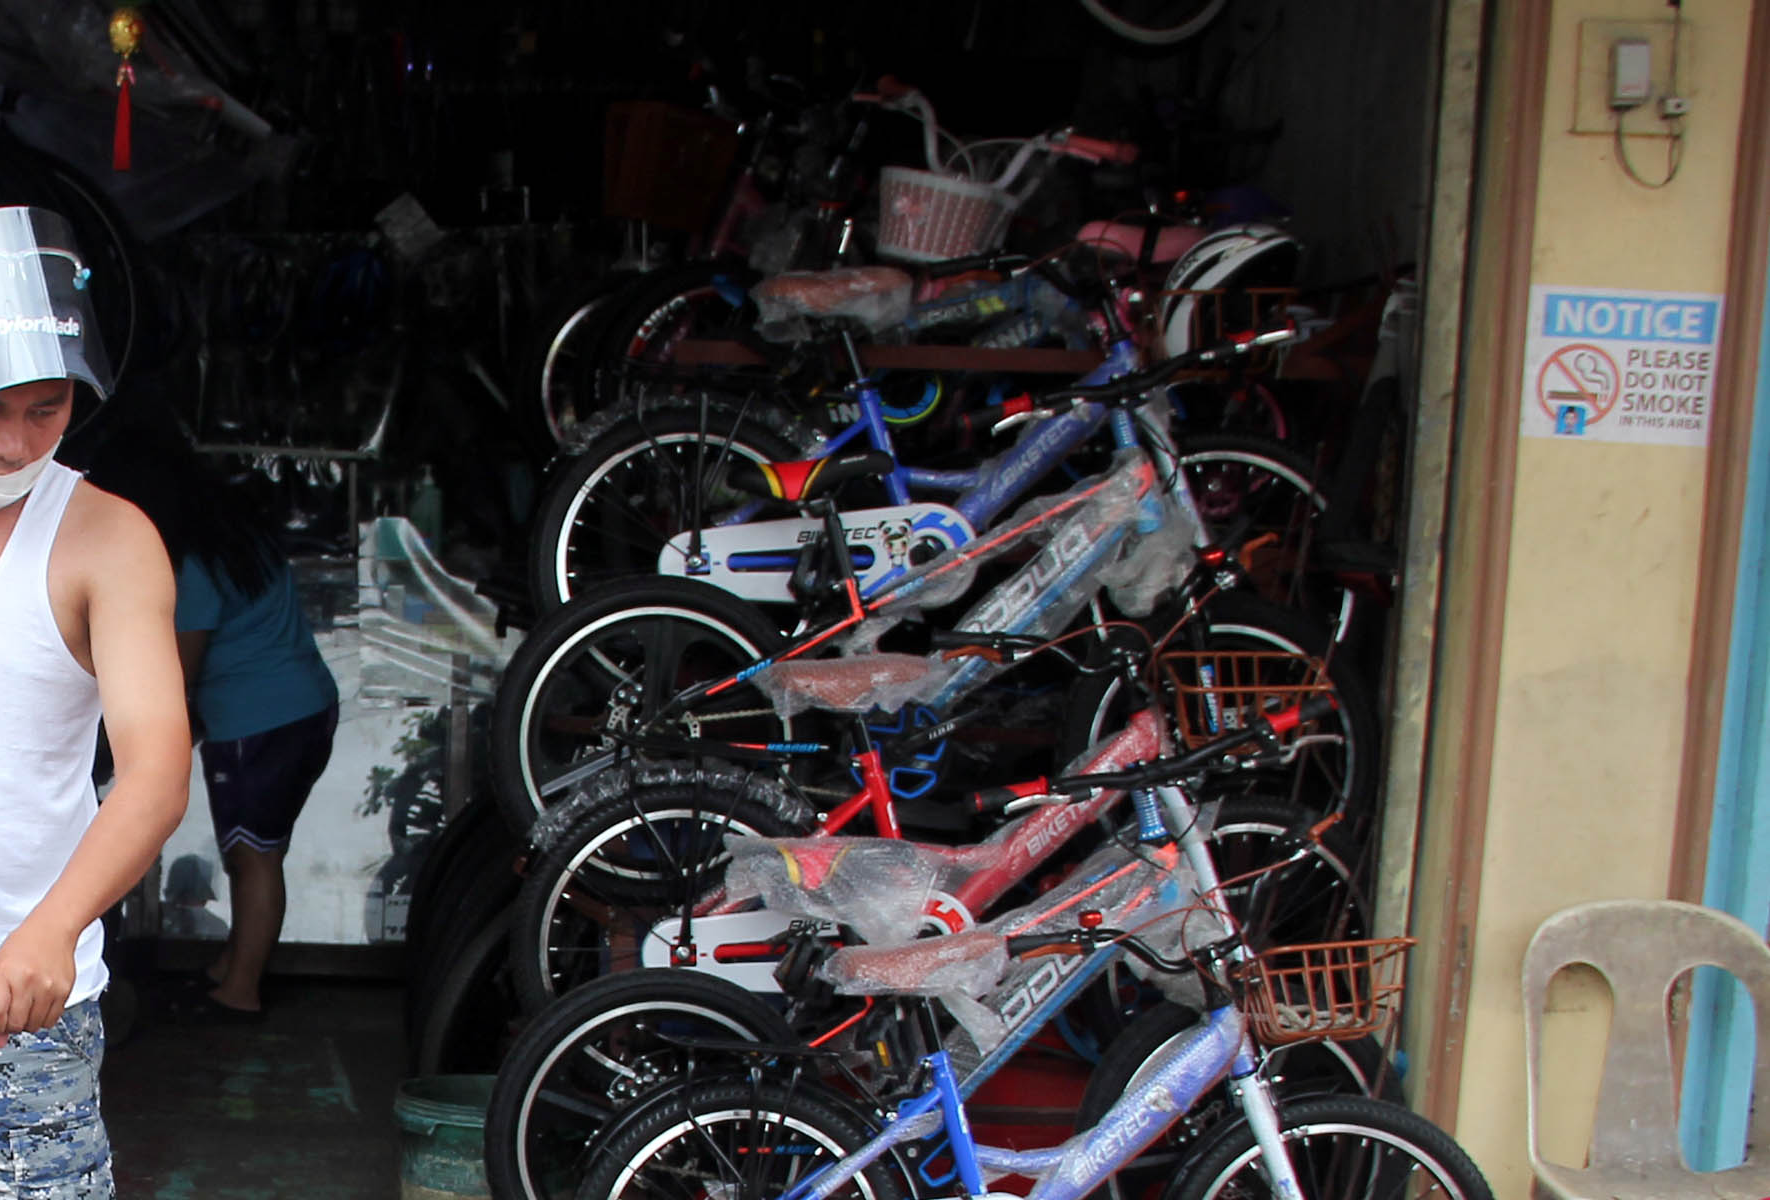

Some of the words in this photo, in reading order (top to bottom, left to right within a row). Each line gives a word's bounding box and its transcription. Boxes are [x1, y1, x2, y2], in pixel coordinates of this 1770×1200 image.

[1553, 298, 1706, 340] NOTICE
[1626, 348, 1711, 371] PLEASE
[1623, 371, 1657, 390] DO
[1661, 373, 1707, 392] NOT
[1621, 392, 1706, 416] SMOKE
[1636, 417, 1664, 429] THIS
[1668, 419, 1702, 431] AREA
[796, 526, 877, 544] BITEC
[789, 918, 834, 933] BIKE
